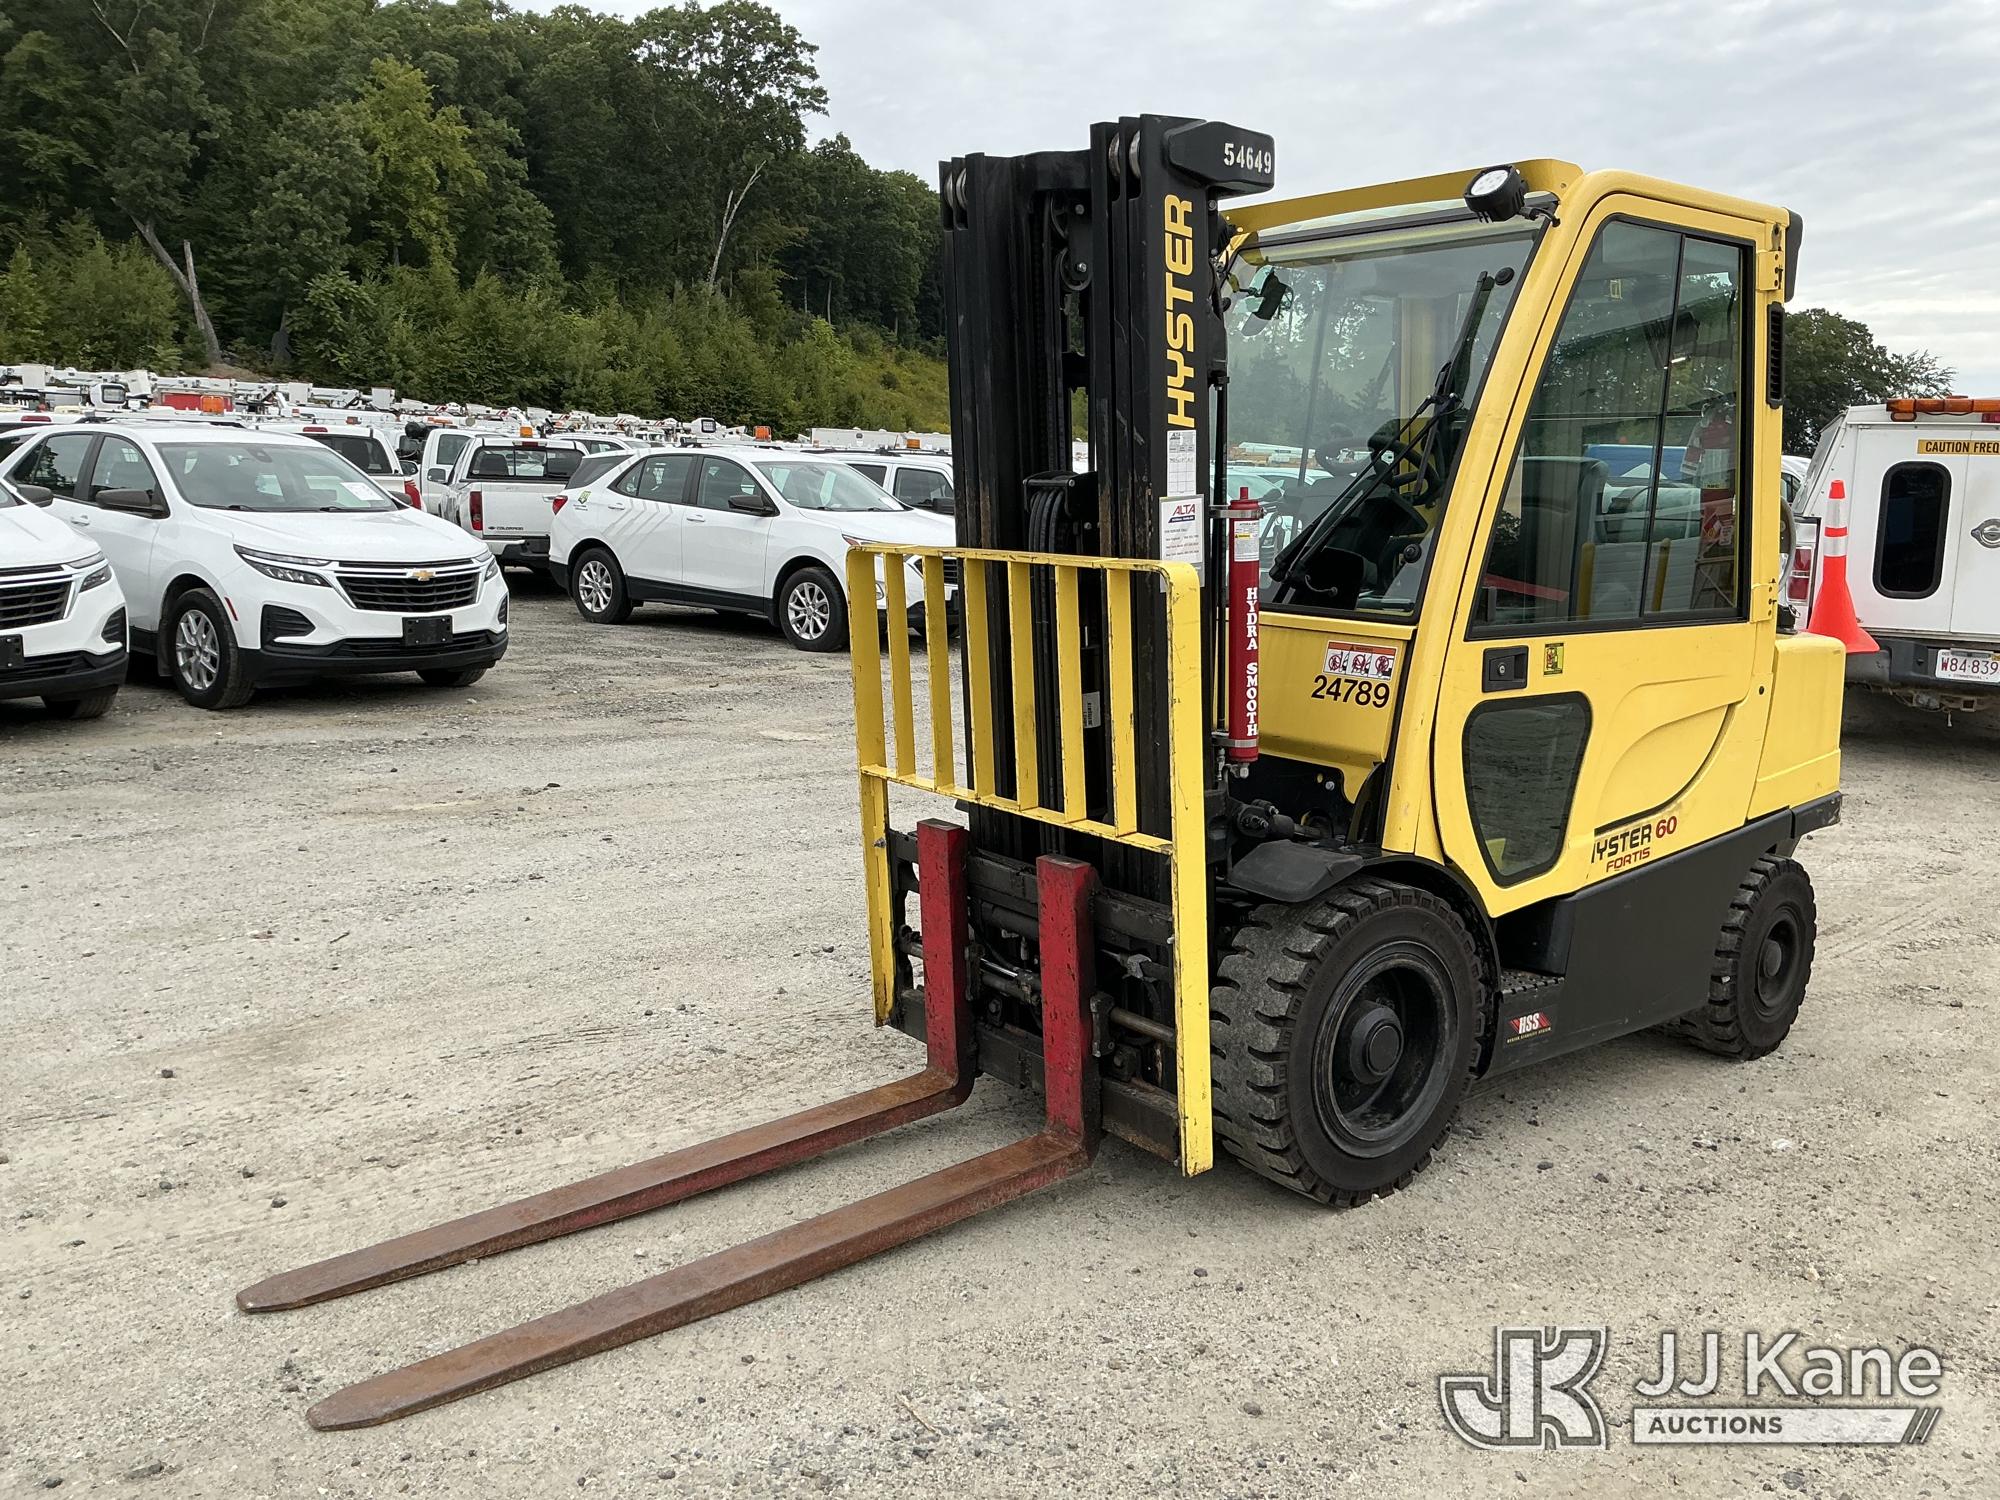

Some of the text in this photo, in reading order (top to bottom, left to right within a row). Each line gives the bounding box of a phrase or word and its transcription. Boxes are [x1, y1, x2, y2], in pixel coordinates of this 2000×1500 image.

[1223, 142, 1272, 174] 54649
[1164, 194, 1195, 428] HYSTER
[1925, 441, 1970, 453] CAUTION
[1172, 503, 1196, 516] ALTA
[1246, 587, 1258, 737] HYDRA SMOOTH
[1311, 674, 1390, 709] 24789
[1655, 815, 1678, 839] 60
[1606, 846, 1651, 873] FORTIS
[1518, 1012, 1540, 1035] HSS
